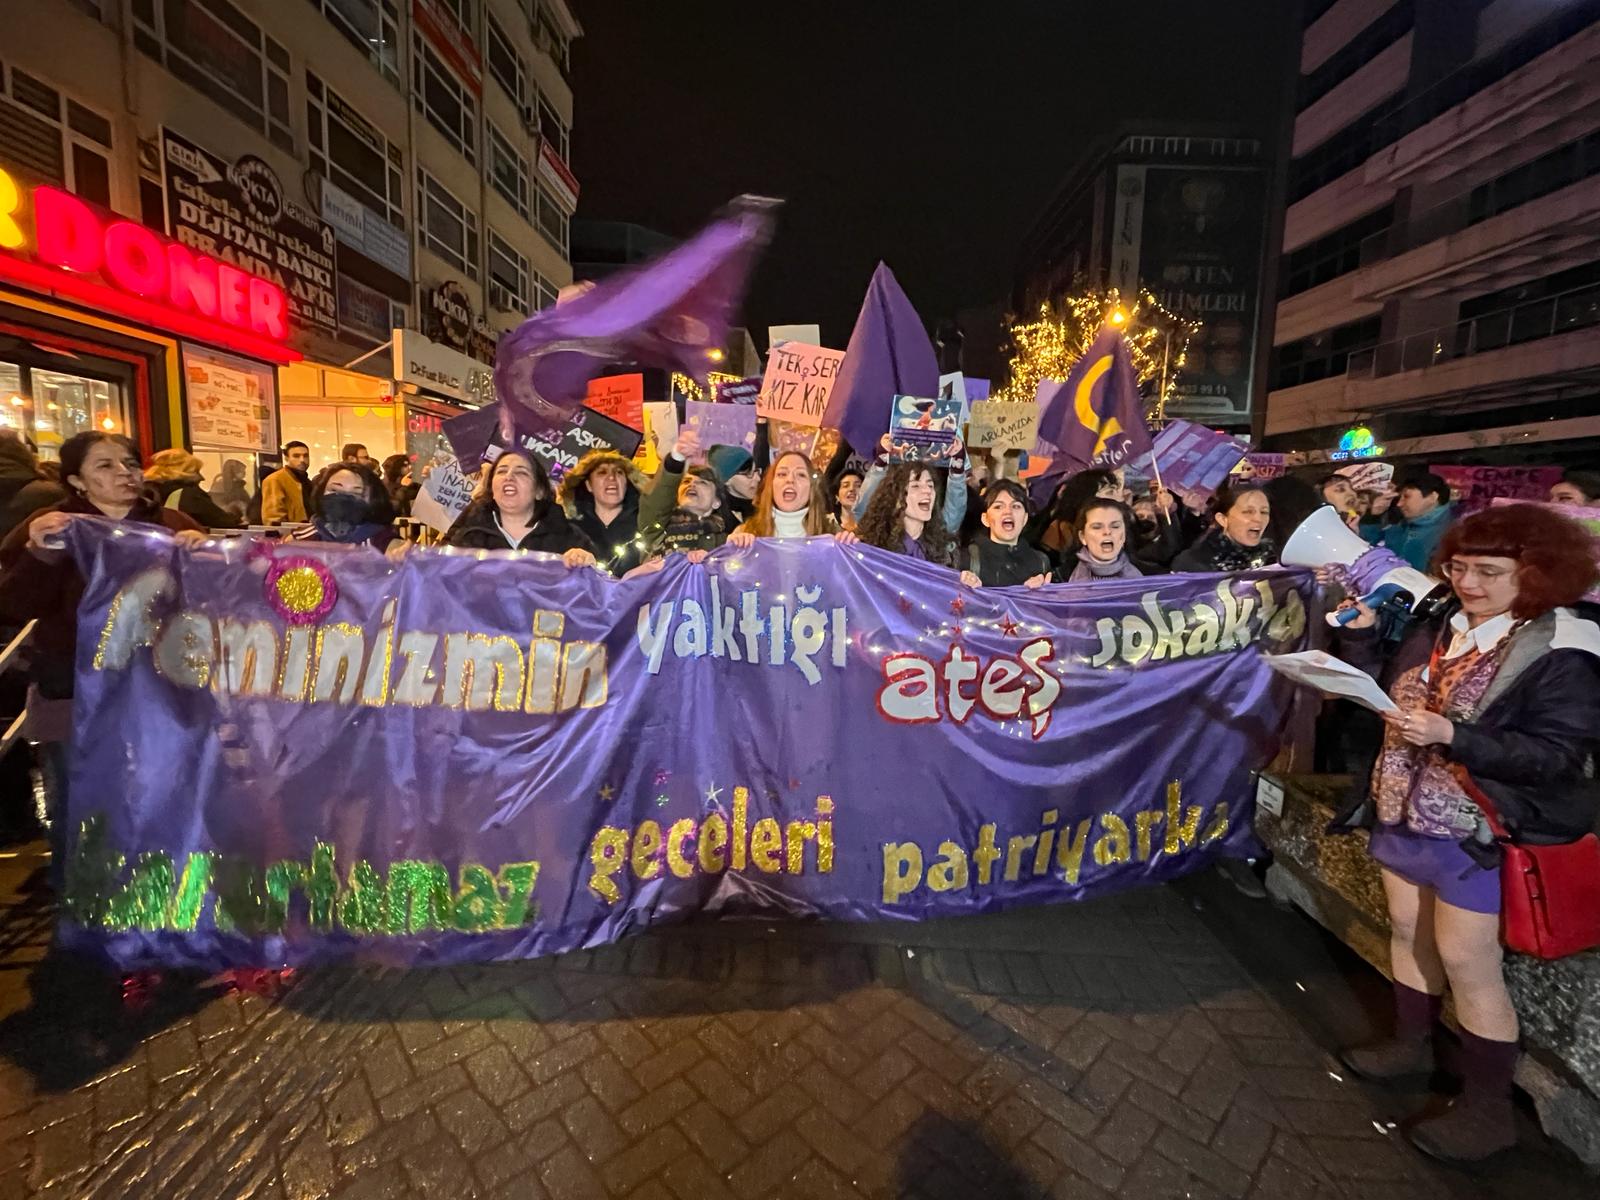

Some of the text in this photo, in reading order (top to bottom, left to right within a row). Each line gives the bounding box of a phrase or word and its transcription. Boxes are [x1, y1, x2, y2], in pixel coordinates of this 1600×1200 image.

[226, 164, 277, 208] NOKTA
[767, 379, 799, 411] KIZ
[637, 575, 848, 686] yaktığı
[876, 637, 1065, 741] ateş
[588, 786, 836, 904] geceleri
